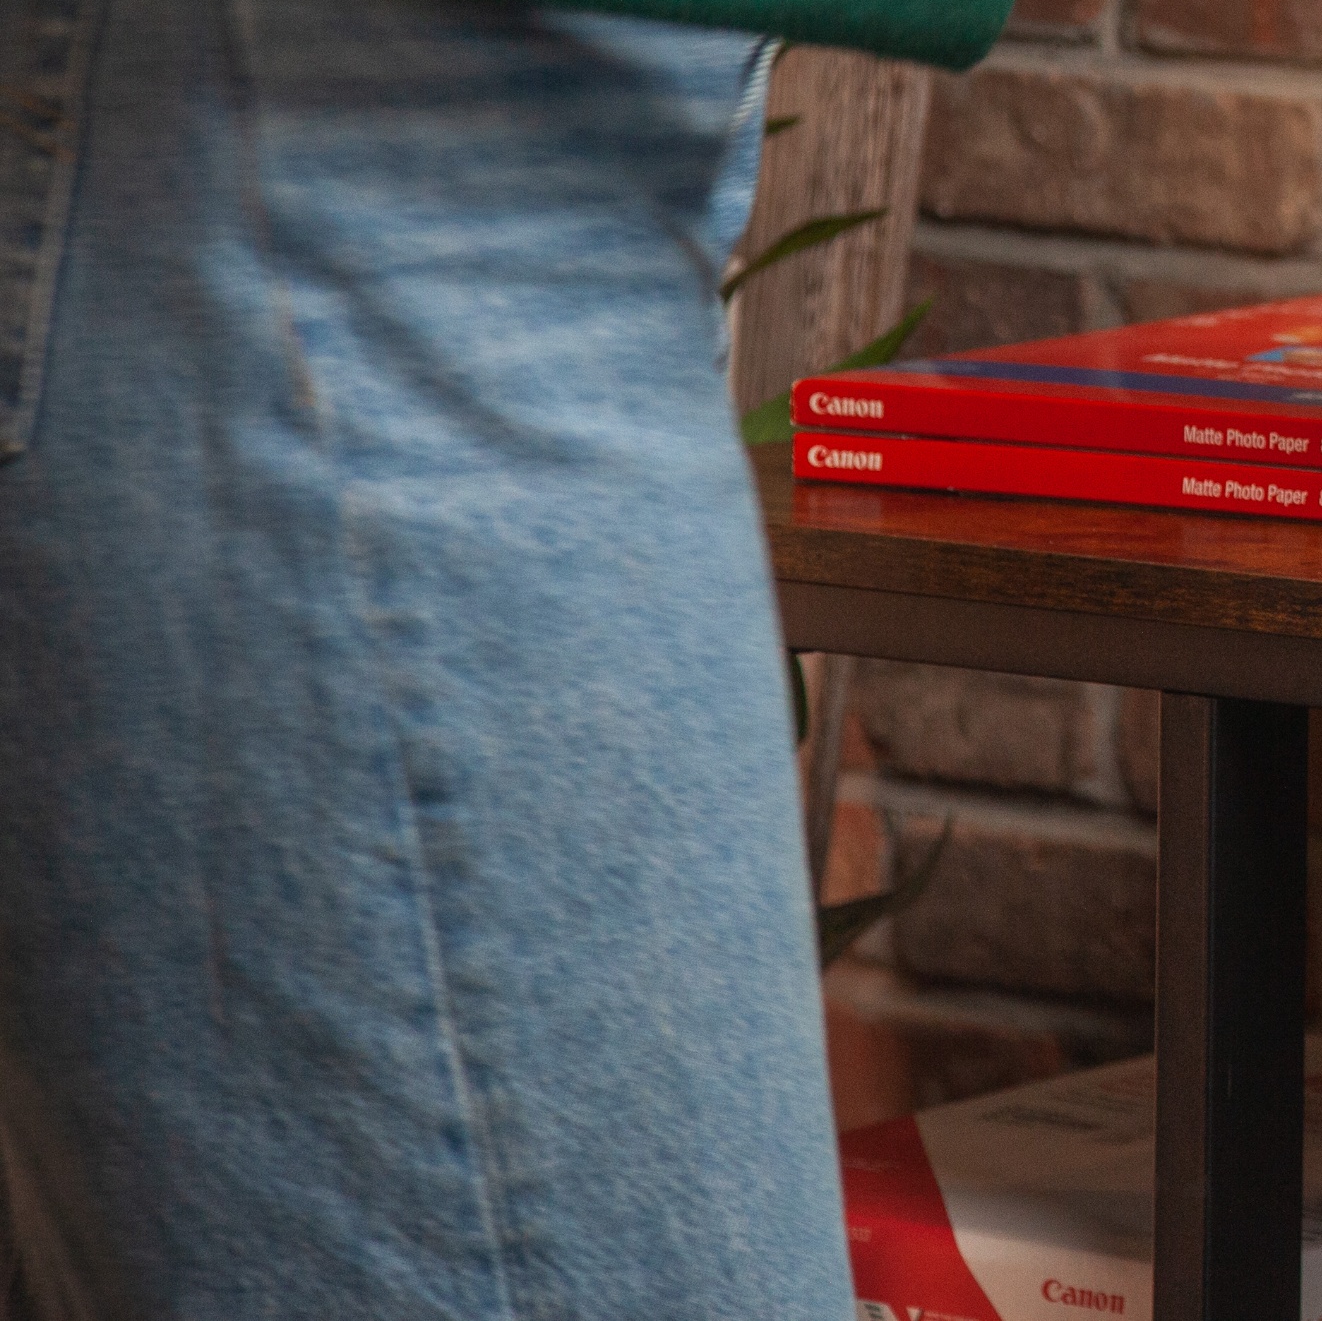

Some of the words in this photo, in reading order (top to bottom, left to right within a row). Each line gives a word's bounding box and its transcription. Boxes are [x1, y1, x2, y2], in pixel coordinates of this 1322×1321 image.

[809, 392, 885, 419] Canon
[1184, 425, 1223, 446] Matte
[1226, 428, 1266, 449] Photo
[1269, 432, 1308, 455] Paper
[807, 444, 883, 471] Canon
[1182, 476, 1222, 498] Matte
[1225, 480, 1264, 501] Photo
[1267, 484, 1307, 506] Paper
[1041, 1278, 1126, 1316] Canon
